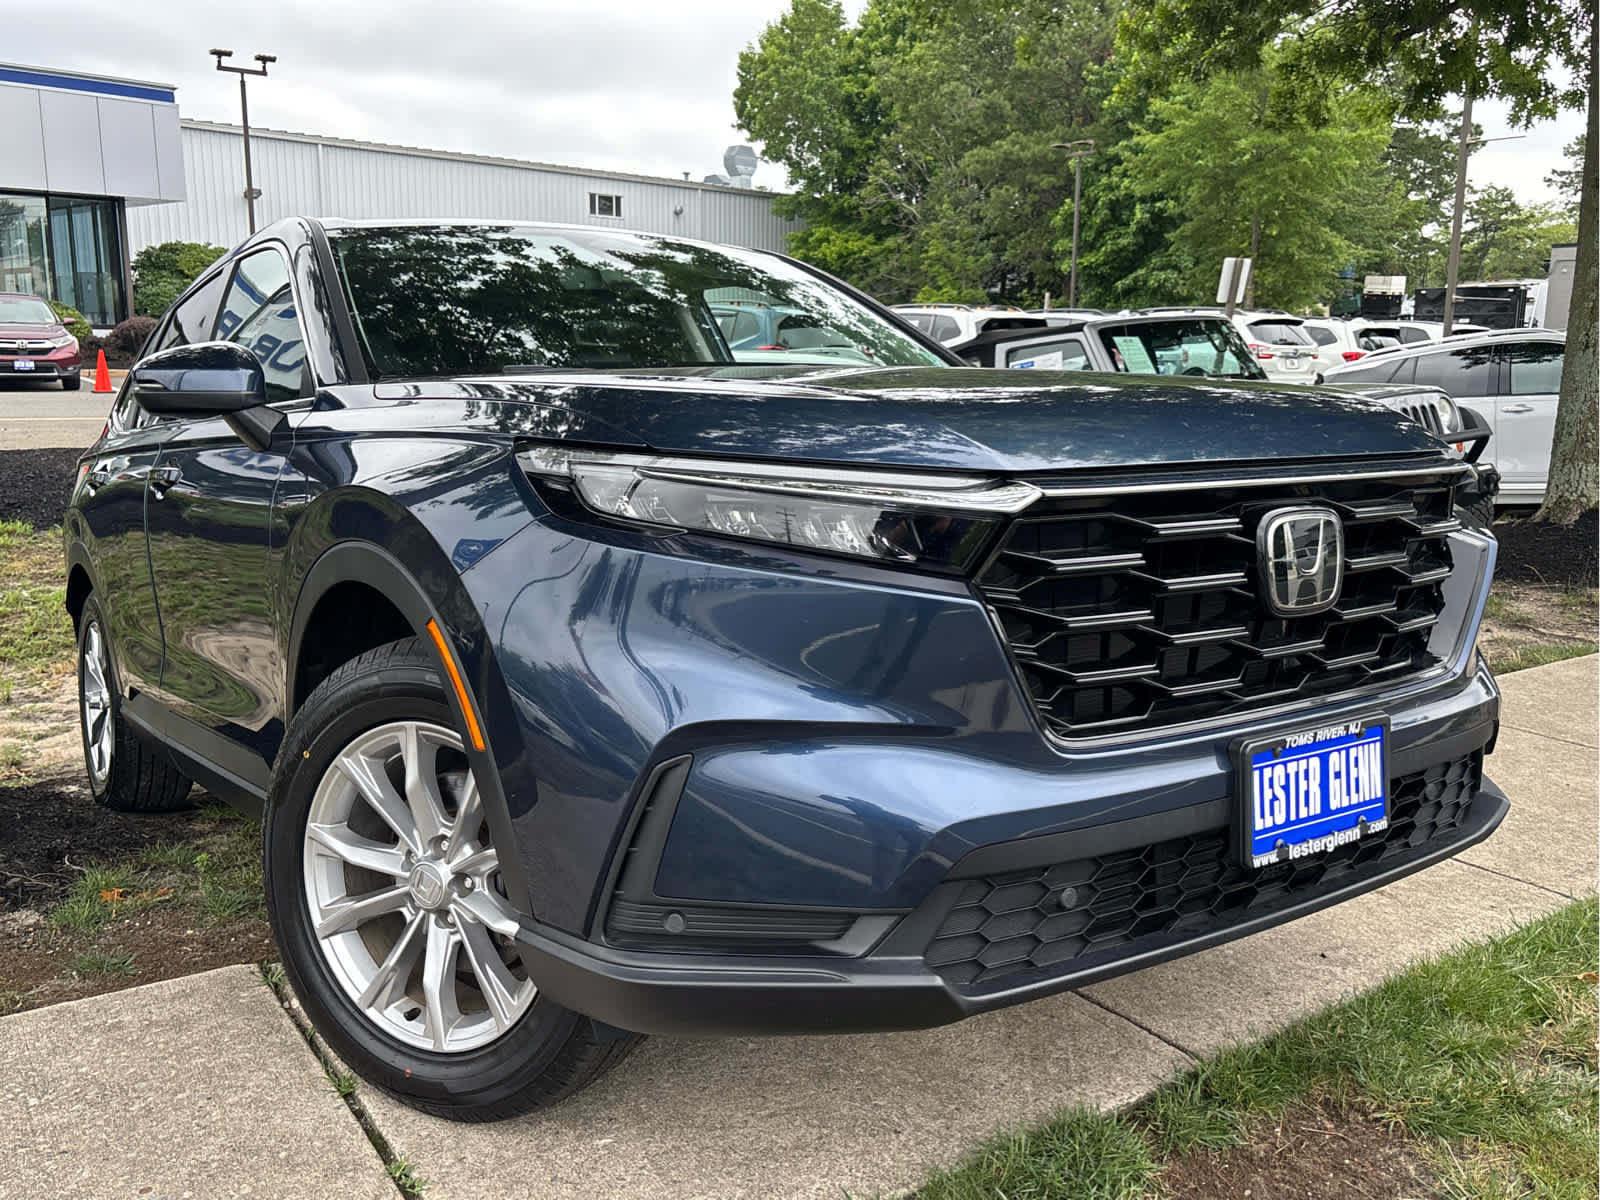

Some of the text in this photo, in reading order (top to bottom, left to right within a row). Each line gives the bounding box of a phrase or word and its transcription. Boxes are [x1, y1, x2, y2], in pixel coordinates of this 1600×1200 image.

[1285, 731, 1314, 749] TOMS
[1348, 721, 1362, 735] NJ
[1253, 741, 1382, 831] LESTER GLENN
